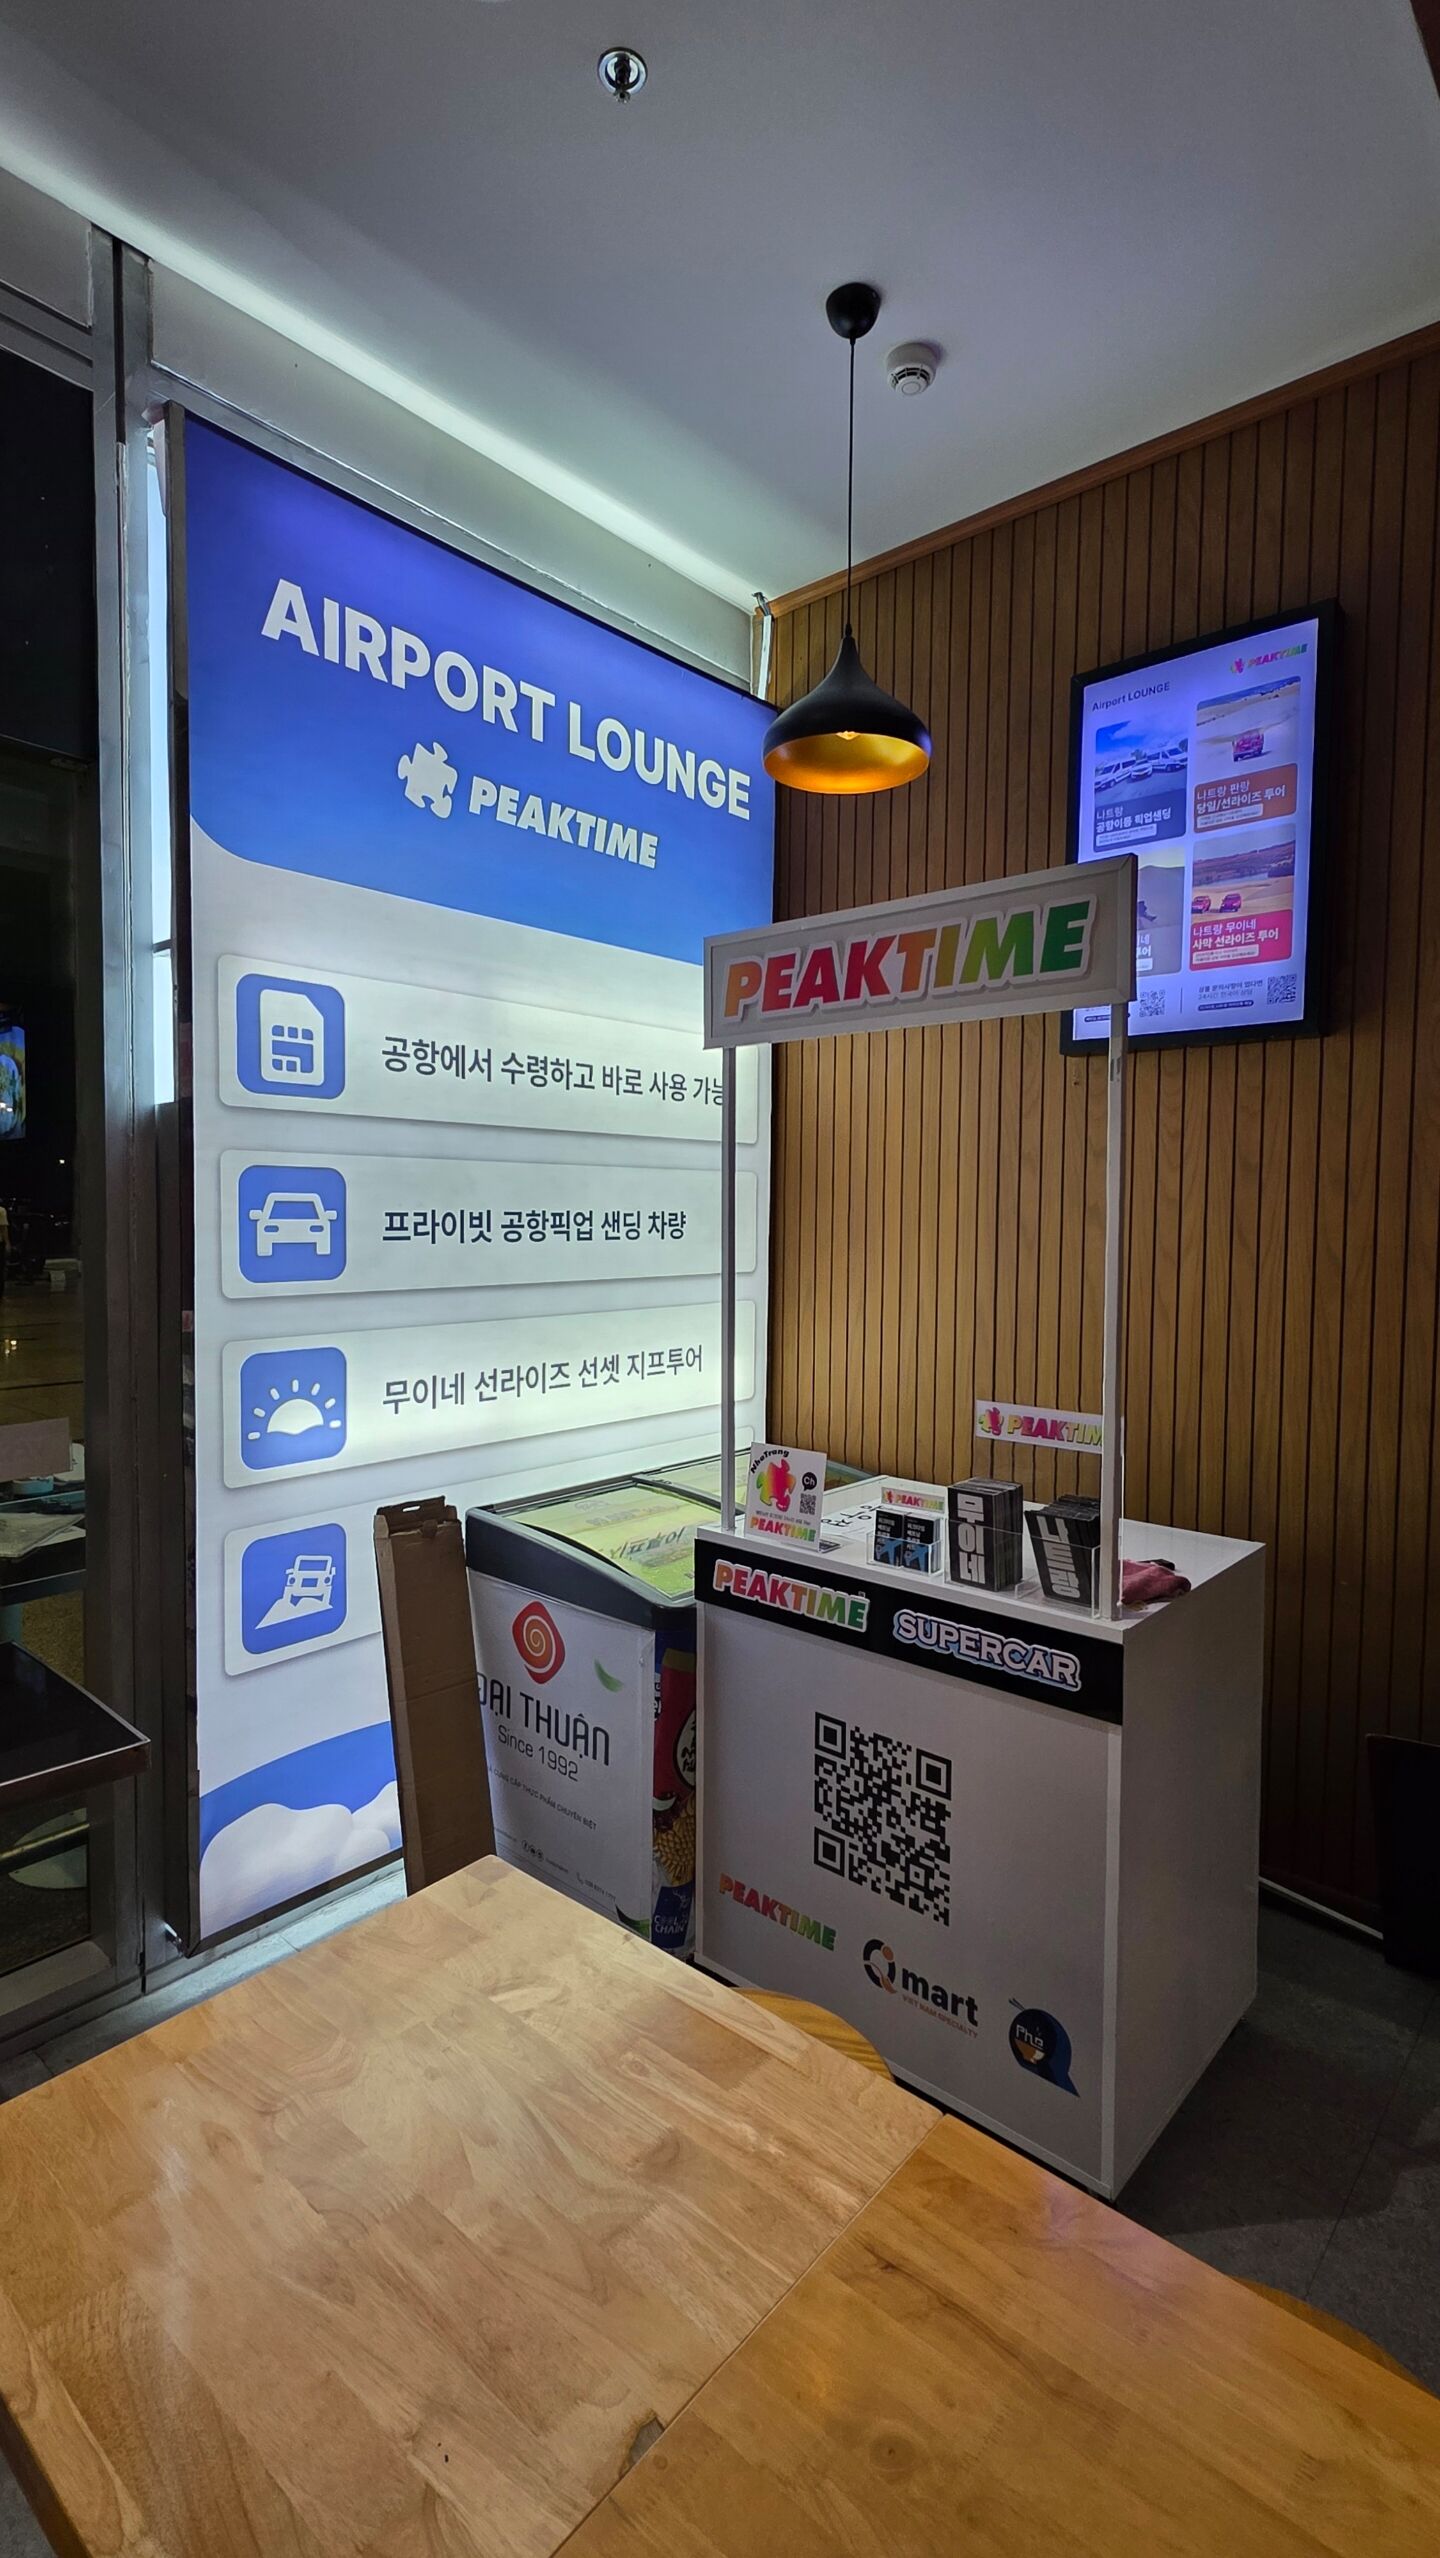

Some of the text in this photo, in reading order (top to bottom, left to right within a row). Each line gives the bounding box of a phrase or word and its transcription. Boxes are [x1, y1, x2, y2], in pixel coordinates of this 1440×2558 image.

[261, 578, 751, 821] AIRPORT LOUNGE
[1092, 681, 1171, 712] Airport LOUNGE
[469, 776, 659, 869] PEAKTIME
[1264, 784, 1286, 800] 투어
[722, 899, 1092, 1018] PEAKTIME
[1192, 928, 1279, 950] 사막 선라이즈 투어
[1193, 918, 1257, 937] 나트랑 무이네
[381, 1035, 493, 1082] 공항에서
[500, 1051, 596, 1092] 수령하고
[602, 1066, 644, 1096] 바로
[649, 1073, 689, 1104] 사용
[382, 1209, 687, 1245] 프라이빗 공항픽업 샌딩 차량
[382, 1345, 703, 1414] 무이네 선라이즈 선셋 지프투어
[1007, 1415, 1102, 1446] PEAKTIM
[750, 1515, 817, 1542] PEAKTIME
[957, 1493, 985, 1584] 무이네
[713, 1559, 870, 1632] PEAKTIME
[895, 1611, 1080, 1690] SUPERCAR
[498, 1724, 579, 1782] Since 1992
[719, 1873, 836, 1952] PEAKTIME
